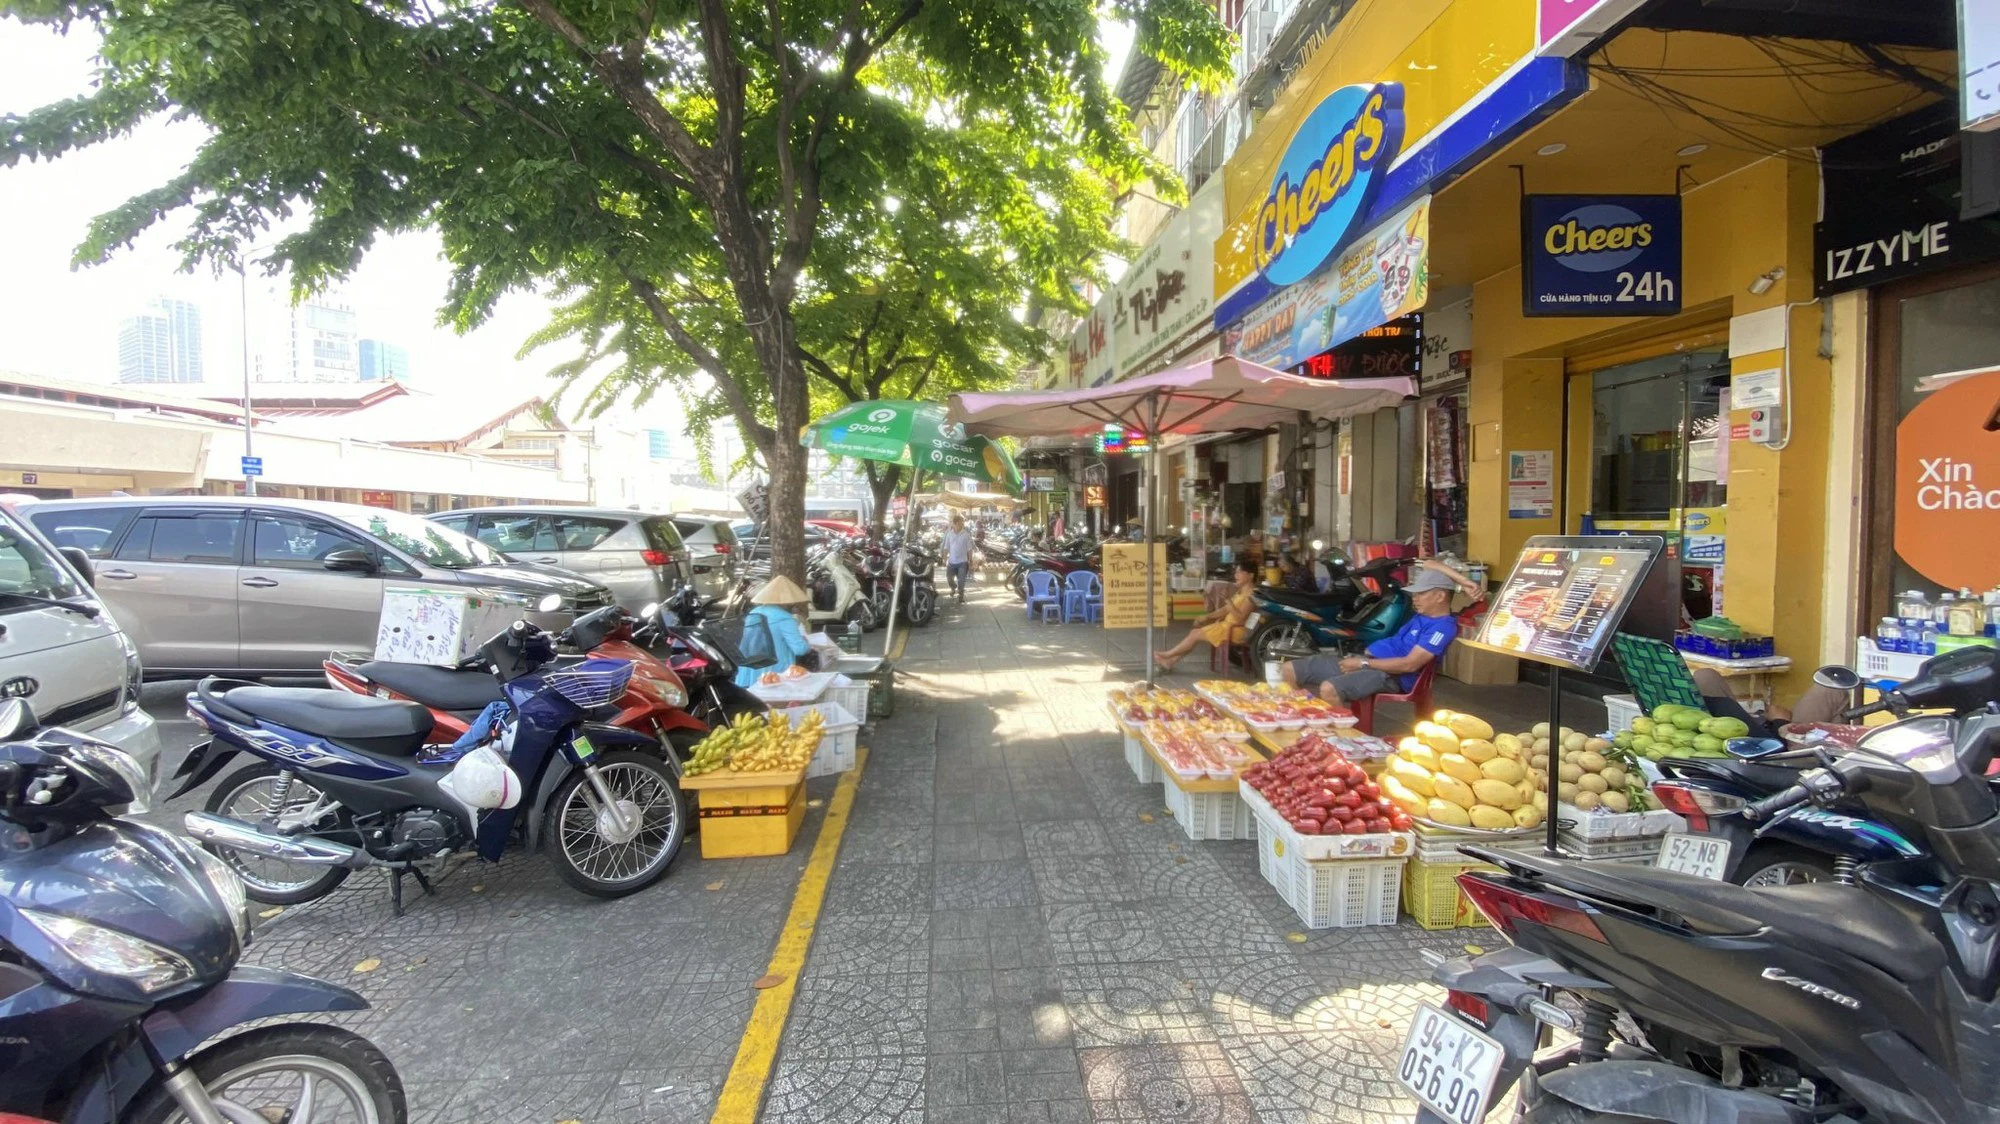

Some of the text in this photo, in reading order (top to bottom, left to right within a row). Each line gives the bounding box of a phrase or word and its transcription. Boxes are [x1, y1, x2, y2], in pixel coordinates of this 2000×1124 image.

[1257, 93, 1383, 268] Cheers
[1544, 220, 1653, 255] Cheers
[1826, 221, 1950, 281] IZZYME
[1540, 291, 1612, 305] CỬA HÀNG TIỆN LỢI
[1615, 271, 1674, 302] 24h
[847, 423, 891, 434] gojek
[932, 439, 975, 452] gocar
[945, 454, 979, 467] gocar
[1917, 457, 1973, 482] Xin
[1, 680, 36, 698] KIA
[1670, 838, 1719, 864] 52-N8
[1458, 1009, 1487, 1029] HONDA
[1420, 1013, 1485, 1080] 94-K2
[1401, 1047, 1480, 1124] 056.90
